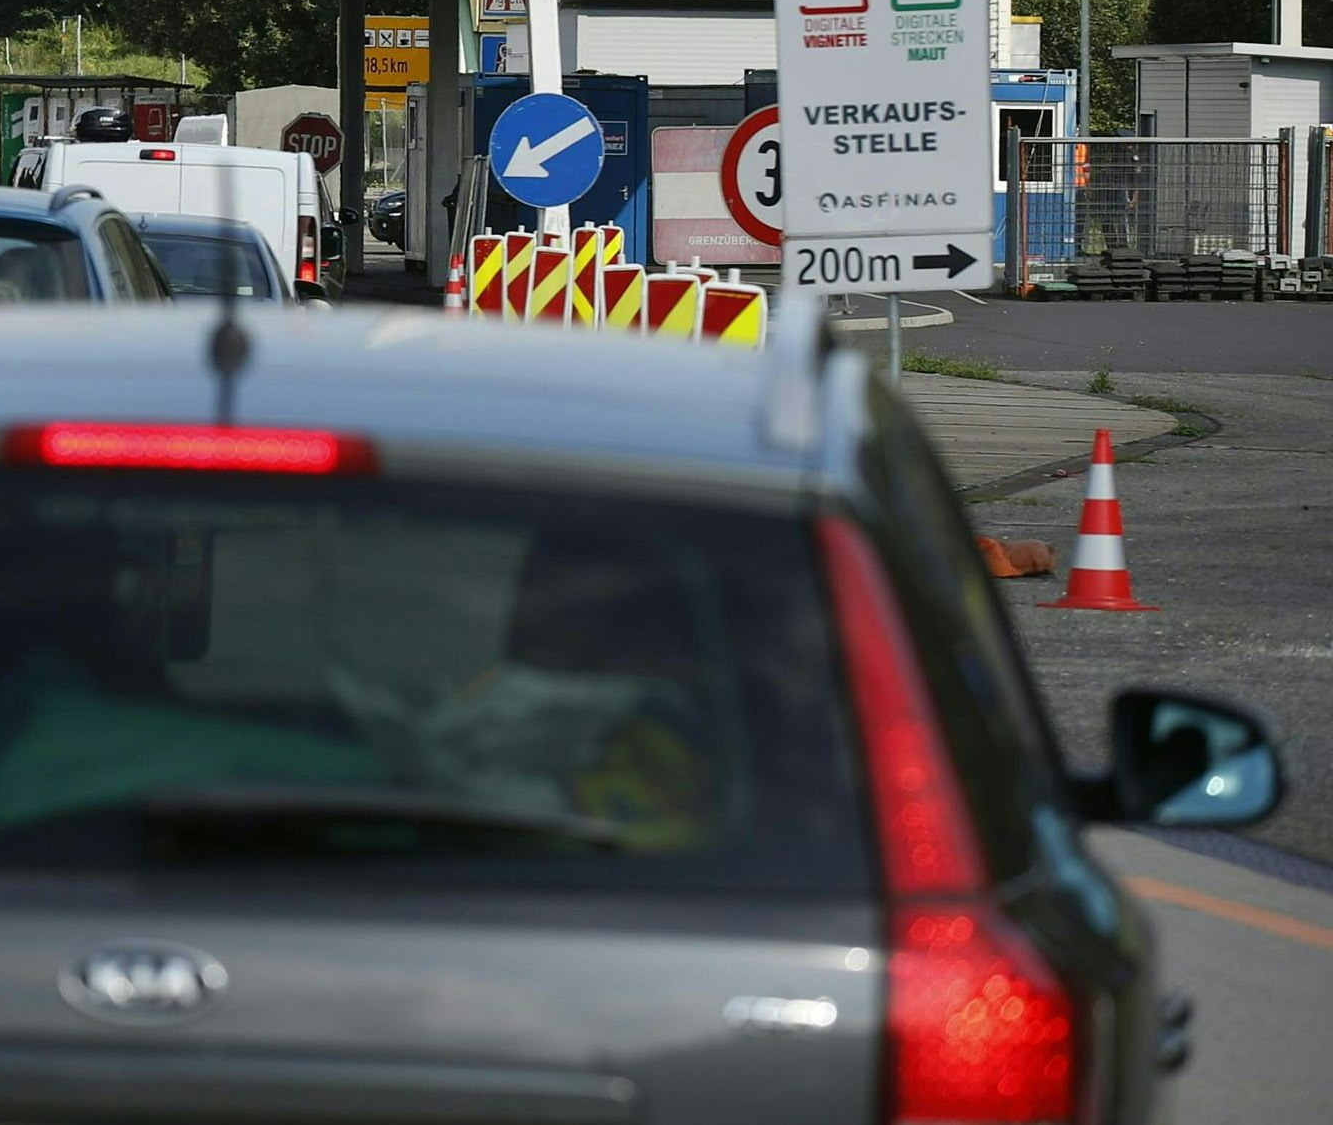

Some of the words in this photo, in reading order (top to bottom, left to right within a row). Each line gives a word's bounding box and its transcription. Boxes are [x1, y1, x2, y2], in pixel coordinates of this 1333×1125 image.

[805, 17, 866, 33] DIGITALE
[895, 13, 958, 30] DIGITALE
[803, 33, 868, 48] VIGNETTE
[891, 29, 964, 46] STRECKEN
[908, 47, 947, 61] MAUT
[365, 57, 388, 75] 18,5
[390, 58, 408, 73] km
[804, 101, 966, 126] VERKAUFS-
[289, 133, 337, 159] STOP
[833, 132, 938, 155] STELLE
[756, 140, 781, 207] 3
[796, 246, 901, 285] 200m
